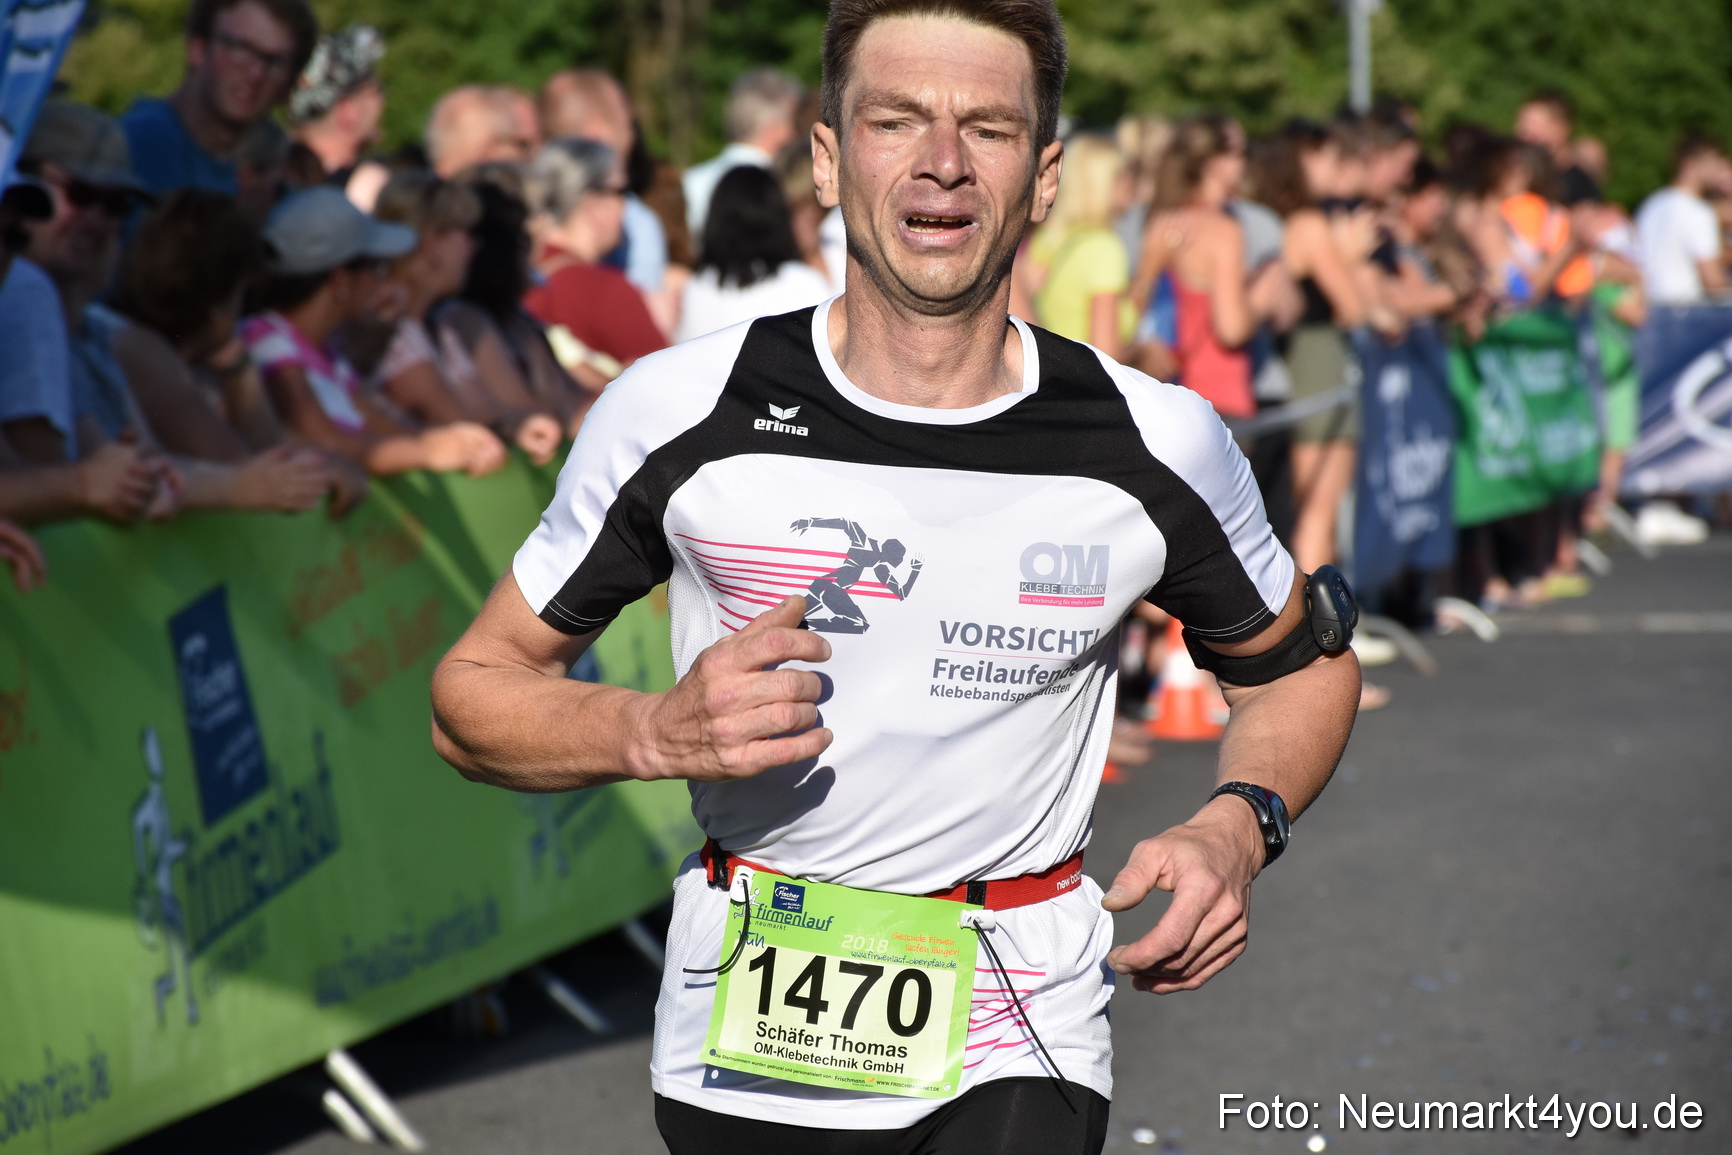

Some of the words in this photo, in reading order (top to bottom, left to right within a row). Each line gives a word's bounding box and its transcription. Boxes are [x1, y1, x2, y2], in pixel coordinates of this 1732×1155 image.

[754, 418, 809, 437] erima
[1019, 541, 1110, 586] OM
[1021, 582, 1058, 594] KLEBE
[1061, 583, 1106, 595] TECHNIK
[1032, 597, 1062, 606] Verbindung
[939, 620, 1101, 656] VORSICHT!
[932, 658, 1080, 686] Freilaufende
[1056, 877, 1070, 891] new
[755, 920, 787, 931] neumarkt
[757, 903, 835, 932] firmenlauf
[841, 933, 889, 954] 2018
[890, 931, 927, 943] Gesunde
[929, 936, 955, 946] Firmen
[851, 950, 957, 969] www.firmenlauf-oberpfalz.de
[905, 943, 929, 954] laufen
[931, 944, 960, 958] länger!
[749, 946, 933, 1038] 1470
[755, 1021, 824, 1048] Schäfer
[829, 1033, 908, 1059] Thomas
[754, 1041, 858, 1070] OM-Klebetechnik
[862, 1059, 905, 1074] GmbH
[722, 1054, 751, 1064] Startnummern
[767, 1063, 785, 1072] gedruckt
[793, 1068, 822, 1078] personalisiert
[834, 1075, 866, 1084] Frischmann
